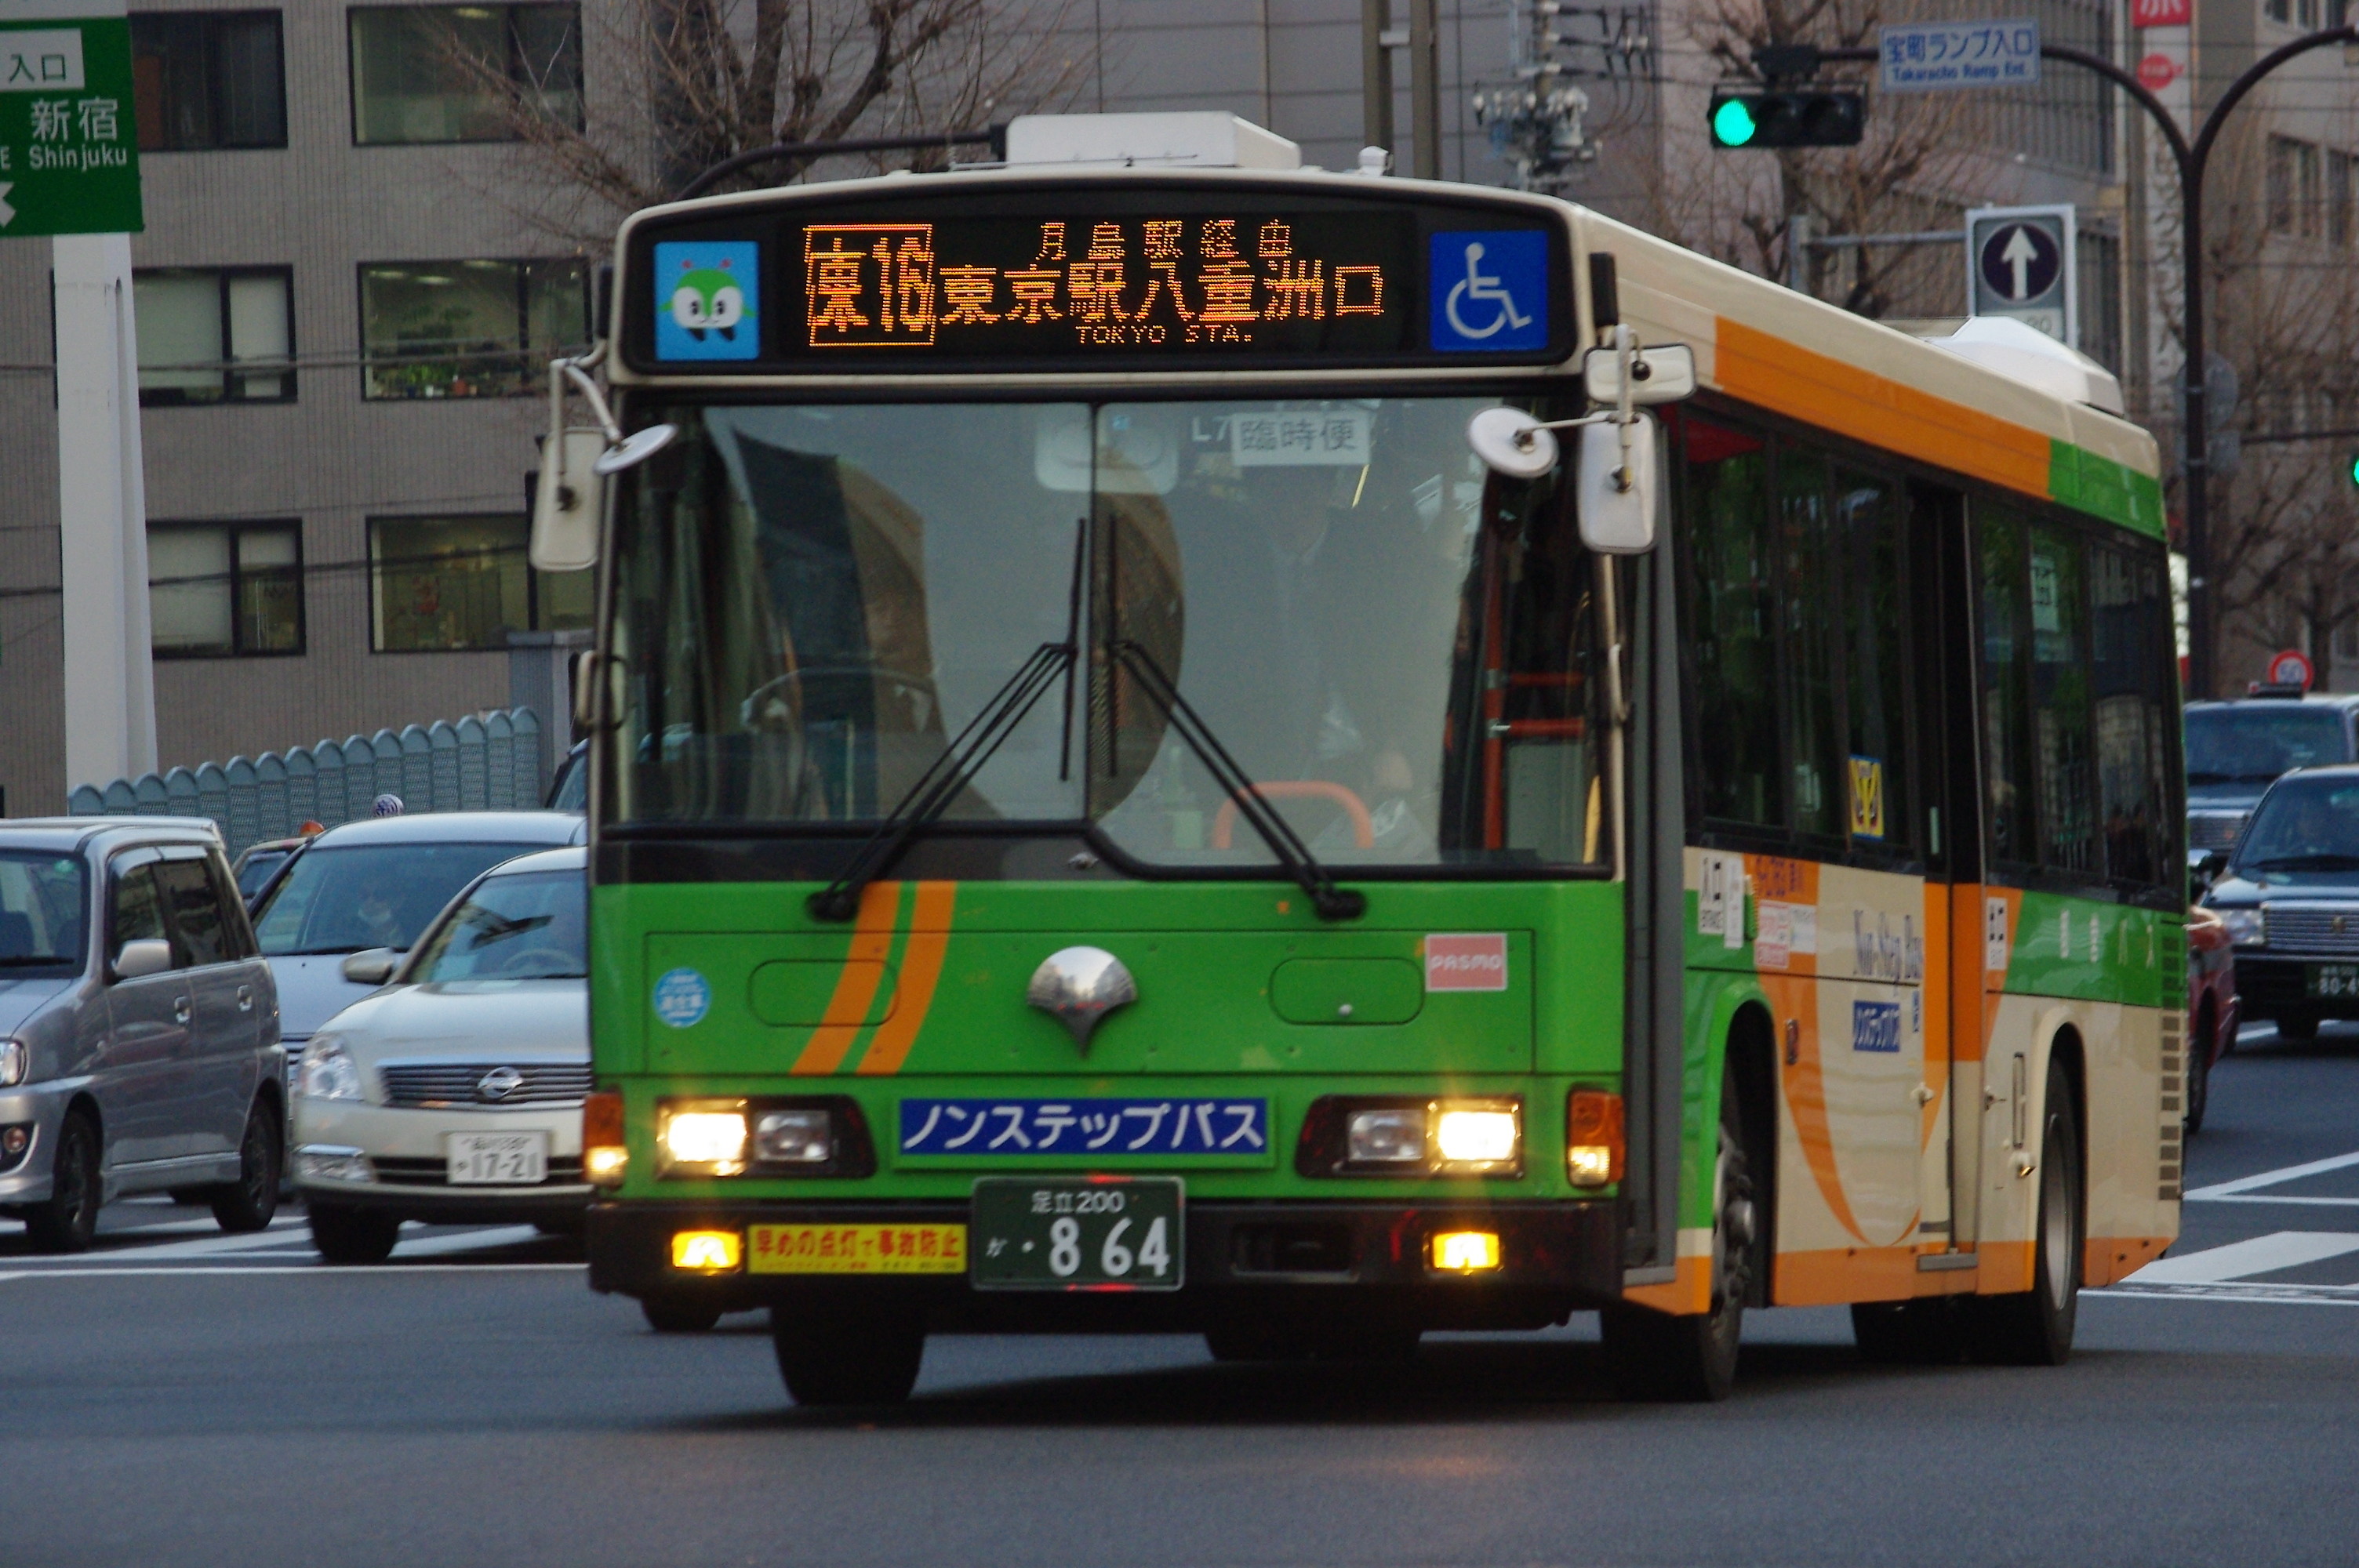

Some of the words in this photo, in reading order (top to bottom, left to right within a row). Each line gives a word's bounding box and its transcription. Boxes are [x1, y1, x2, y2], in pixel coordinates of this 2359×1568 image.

[9, 53, 67, 82] 入口
[30, 95, 118, 143] 新宿
[28, 141, 128, 172] Shinjuku
[1035, 219, 1292, 259] 月島駅経由
[811, 236, 933, 332] 東16
[940, 260, 1385, 325] 東京駅八重洲口
[1074, 325, 1166, 343] TOKYO
[1185, 324, 1252, 343] STA.
[1240, 417, 1357, 452] 臨時便
[1429, 953, 1502, 971] PASMO
[903, 1102, 1264, 1149] ノンステップバス
[471, 1152, 540, 1178] 17-21
